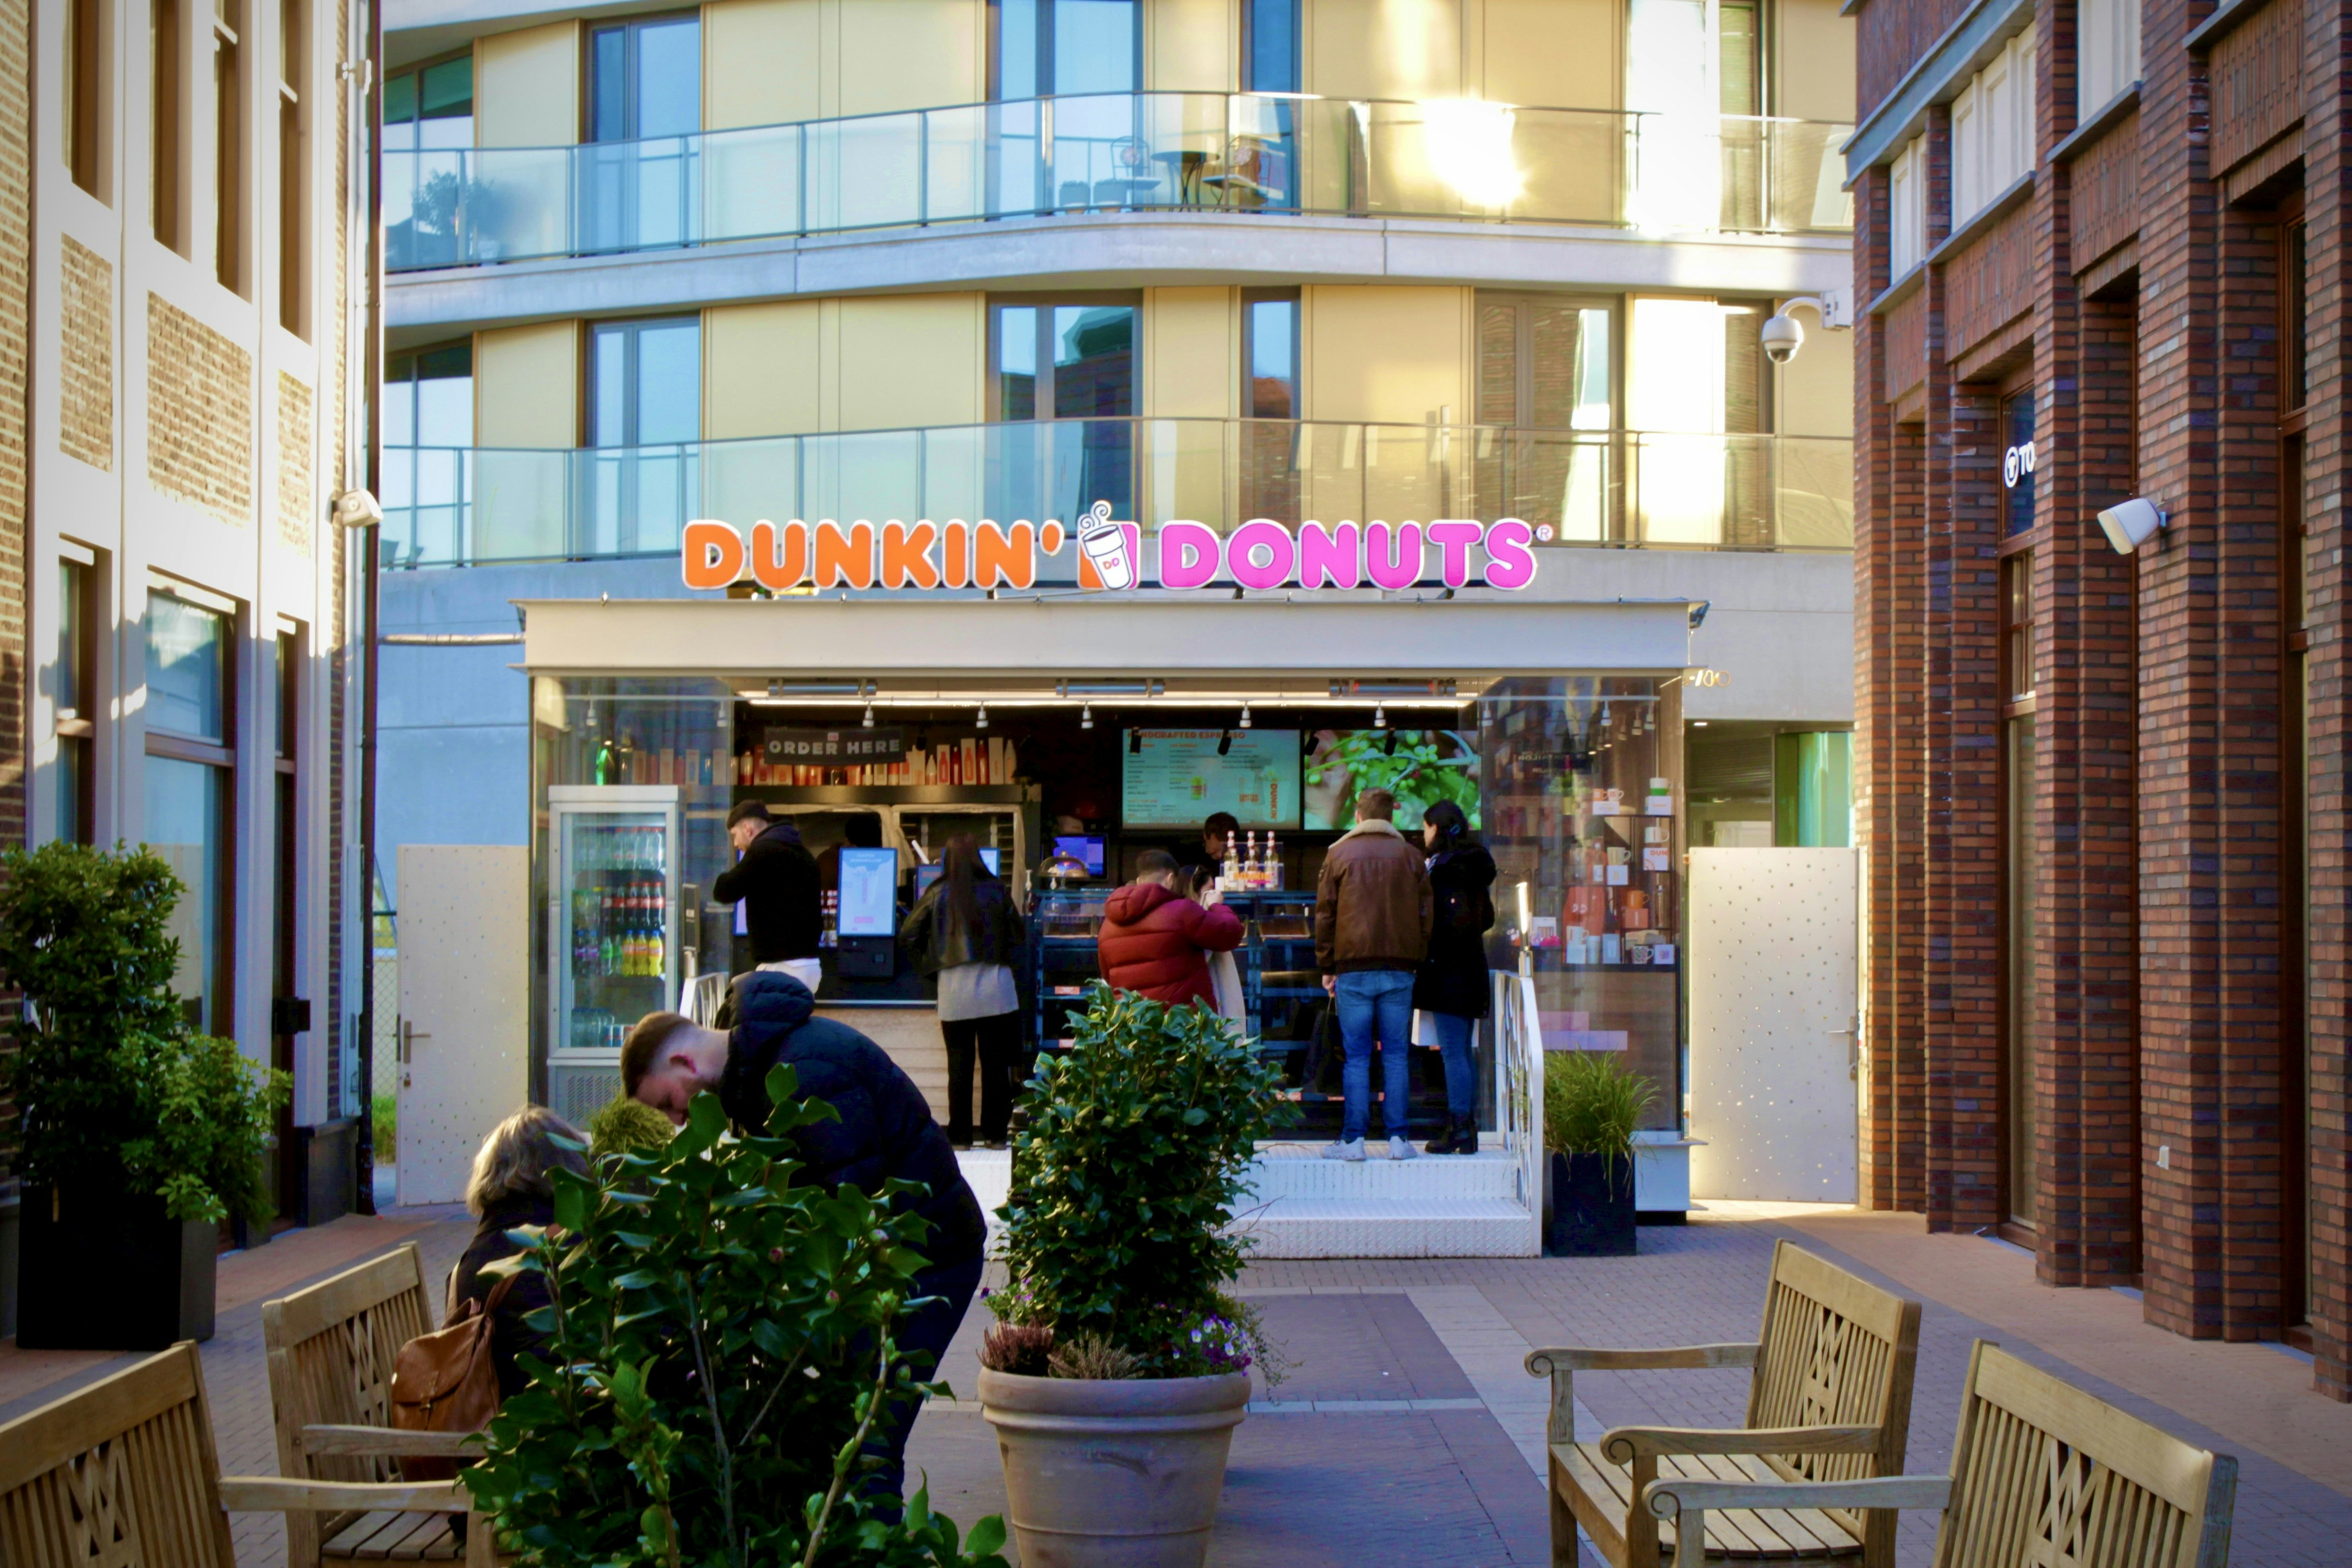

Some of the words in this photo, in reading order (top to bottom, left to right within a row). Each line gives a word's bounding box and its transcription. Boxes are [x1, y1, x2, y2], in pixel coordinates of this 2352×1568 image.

[682, 519, 1064, 590] DUNKIN'
[1158, 518, 1537, 591] DONUTS
[1103, 557, 1120, 570] DD
[769, 741, 837, 755] ORDER
[847, 739, 900, 754] HERE
